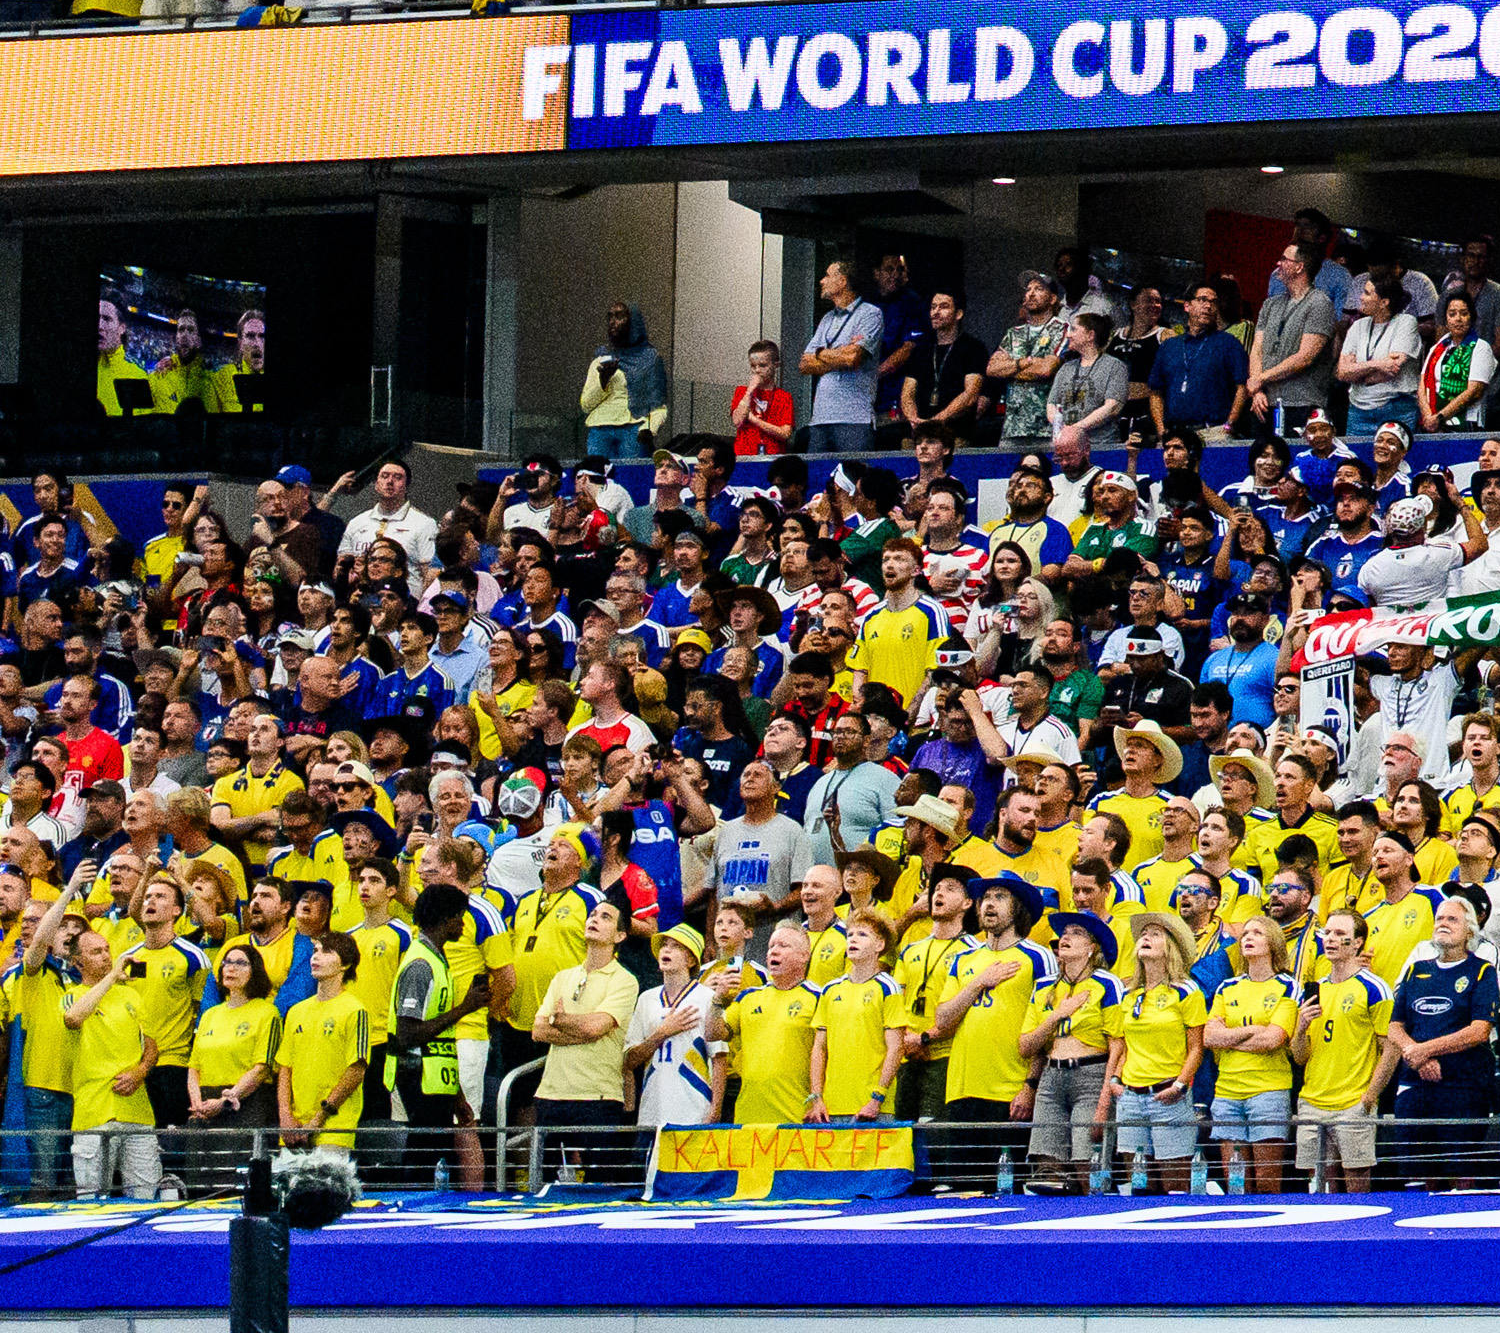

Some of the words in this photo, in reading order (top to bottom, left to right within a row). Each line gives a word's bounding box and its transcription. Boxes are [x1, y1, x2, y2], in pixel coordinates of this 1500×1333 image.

[522, 42, 702, 121] FIFA
[719, 26, 1034, 111] WORLD
[1053, 17, 1228, 97] CUP
[722, 859, 771, 885] JAPAN
[673, 1130, 840, 1173] KALMAR
[852, 1127, 899, 1170] FF
